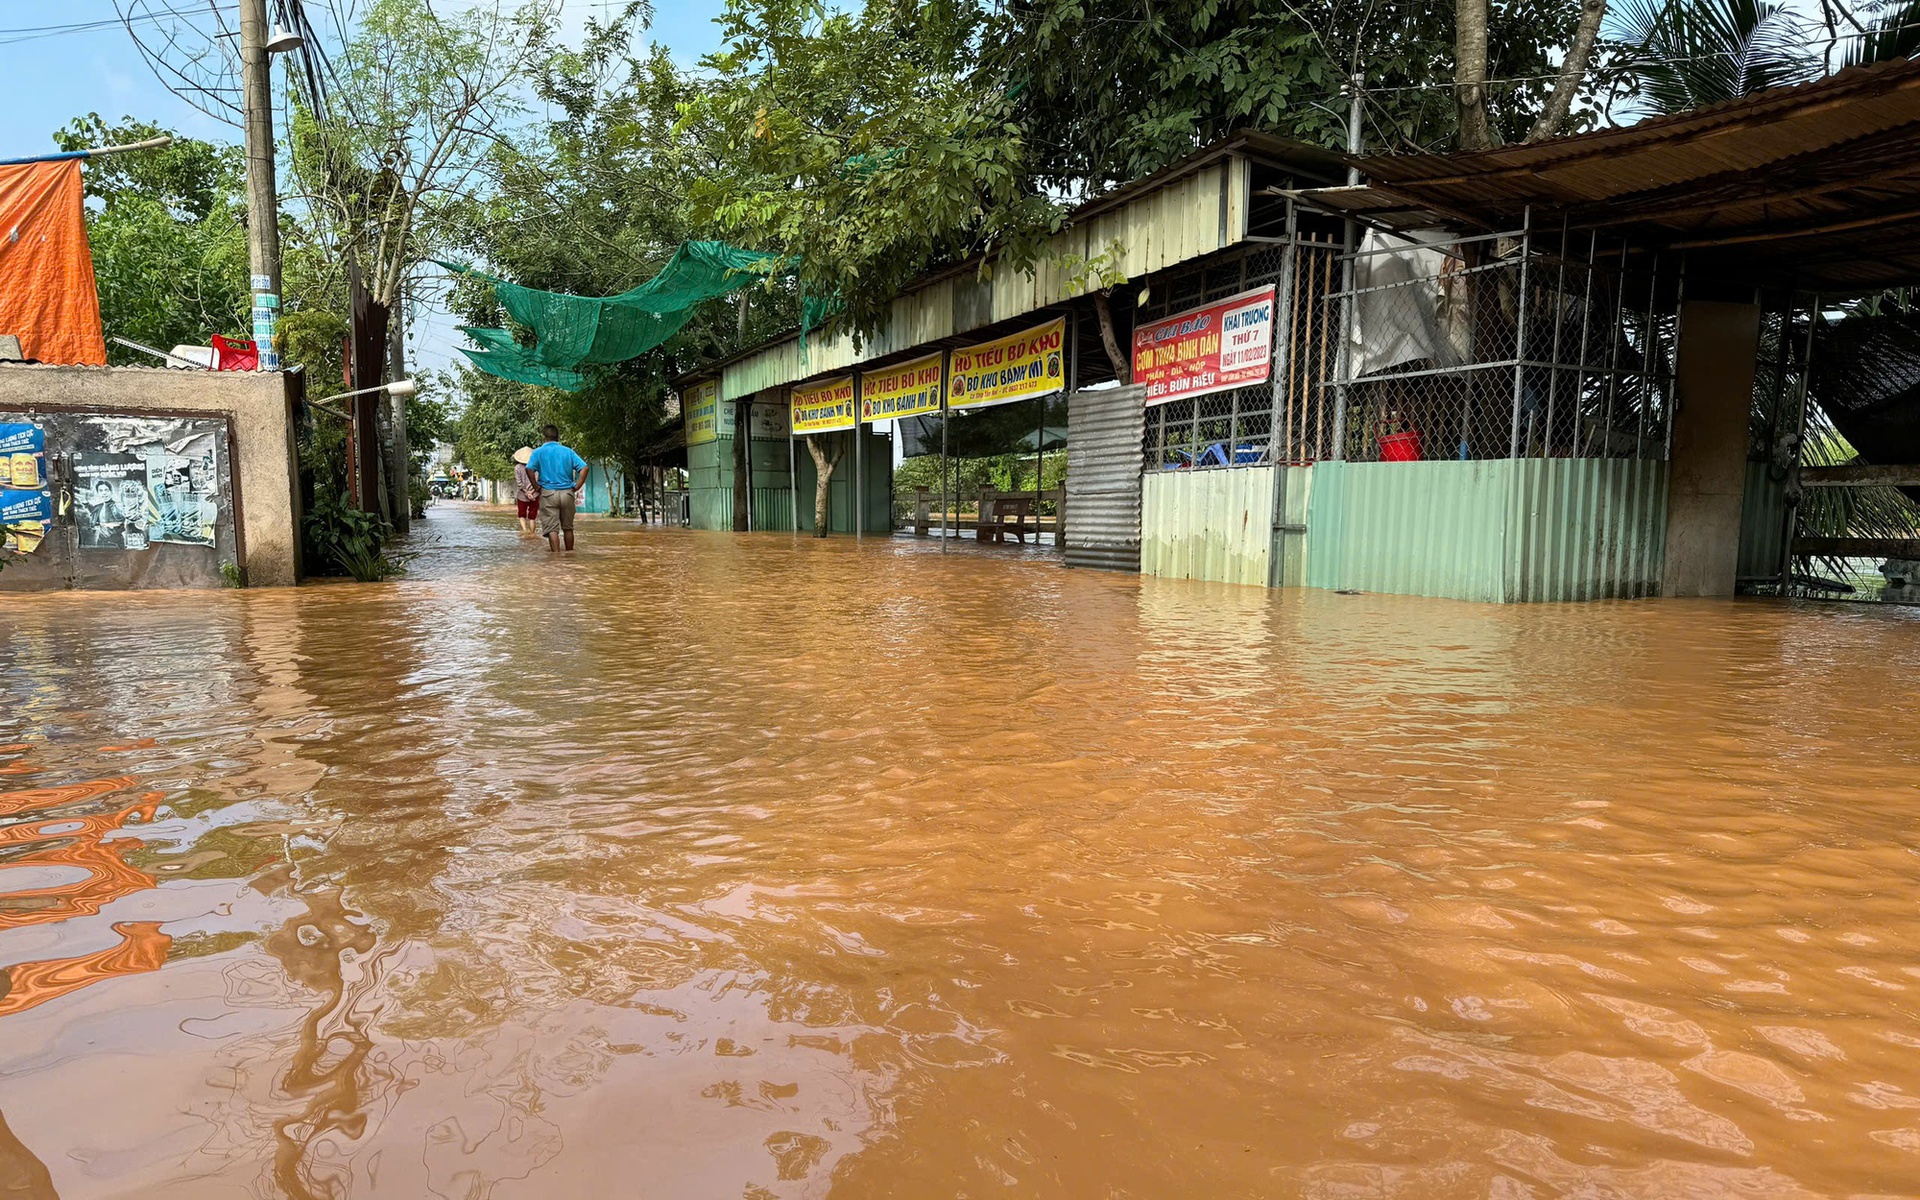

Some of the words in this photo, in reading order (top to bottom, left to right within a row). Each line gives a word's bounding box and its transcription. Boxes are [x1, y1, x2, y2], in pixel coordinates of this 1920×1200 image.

[1155, 324, 1179, 342] GIA
[1180, 314, 1211, 335] BẢO
[1224, 314, 1240, 332] KHAI
[974, 346, 1004, 368] TIẾU
[1007, 339, 1026, 362] BÒ
[1028, 331, 1060, 356] KHO
[1232, 330, 1252, 346] THỨ
[1253, 330, 1260, 340] 7
[1136, 349, 1154, 372] CƠM
[1155, 343, 1175, 366] TRƯA
[1176, 337, 1198, 362] BÌNH
[1200, 331, 1218, 357] DÂN
[1222, 349, 1236, 366] NGÀY
[1238, 344, 1267, 364] 11/02/2023
[966, 372, 979, 392] BÒ
[980, 372, 998, 390] KHO
[1000, 365, 1028, 386] BÁNH
[1028, 356, 1042, 378] MÌ
[1189, 361, 1206, 372] HỘP
[878, 372, 898, 392] TIẾU
[902, 369, 914, 389] BÒ
[918, 366, 940, 386] KHO
[1170, 376, 1190, 392] BÚN
[1192, 372, 1216, 388] RIÊU
[834, 386, 852, 400] KHO
[872, 397, 881, 415] BÒ
[882, 398, 895, 414] KHO
[896, 392, 916, 411] BÁNH
[917, 388, 928, 408] MÌ
